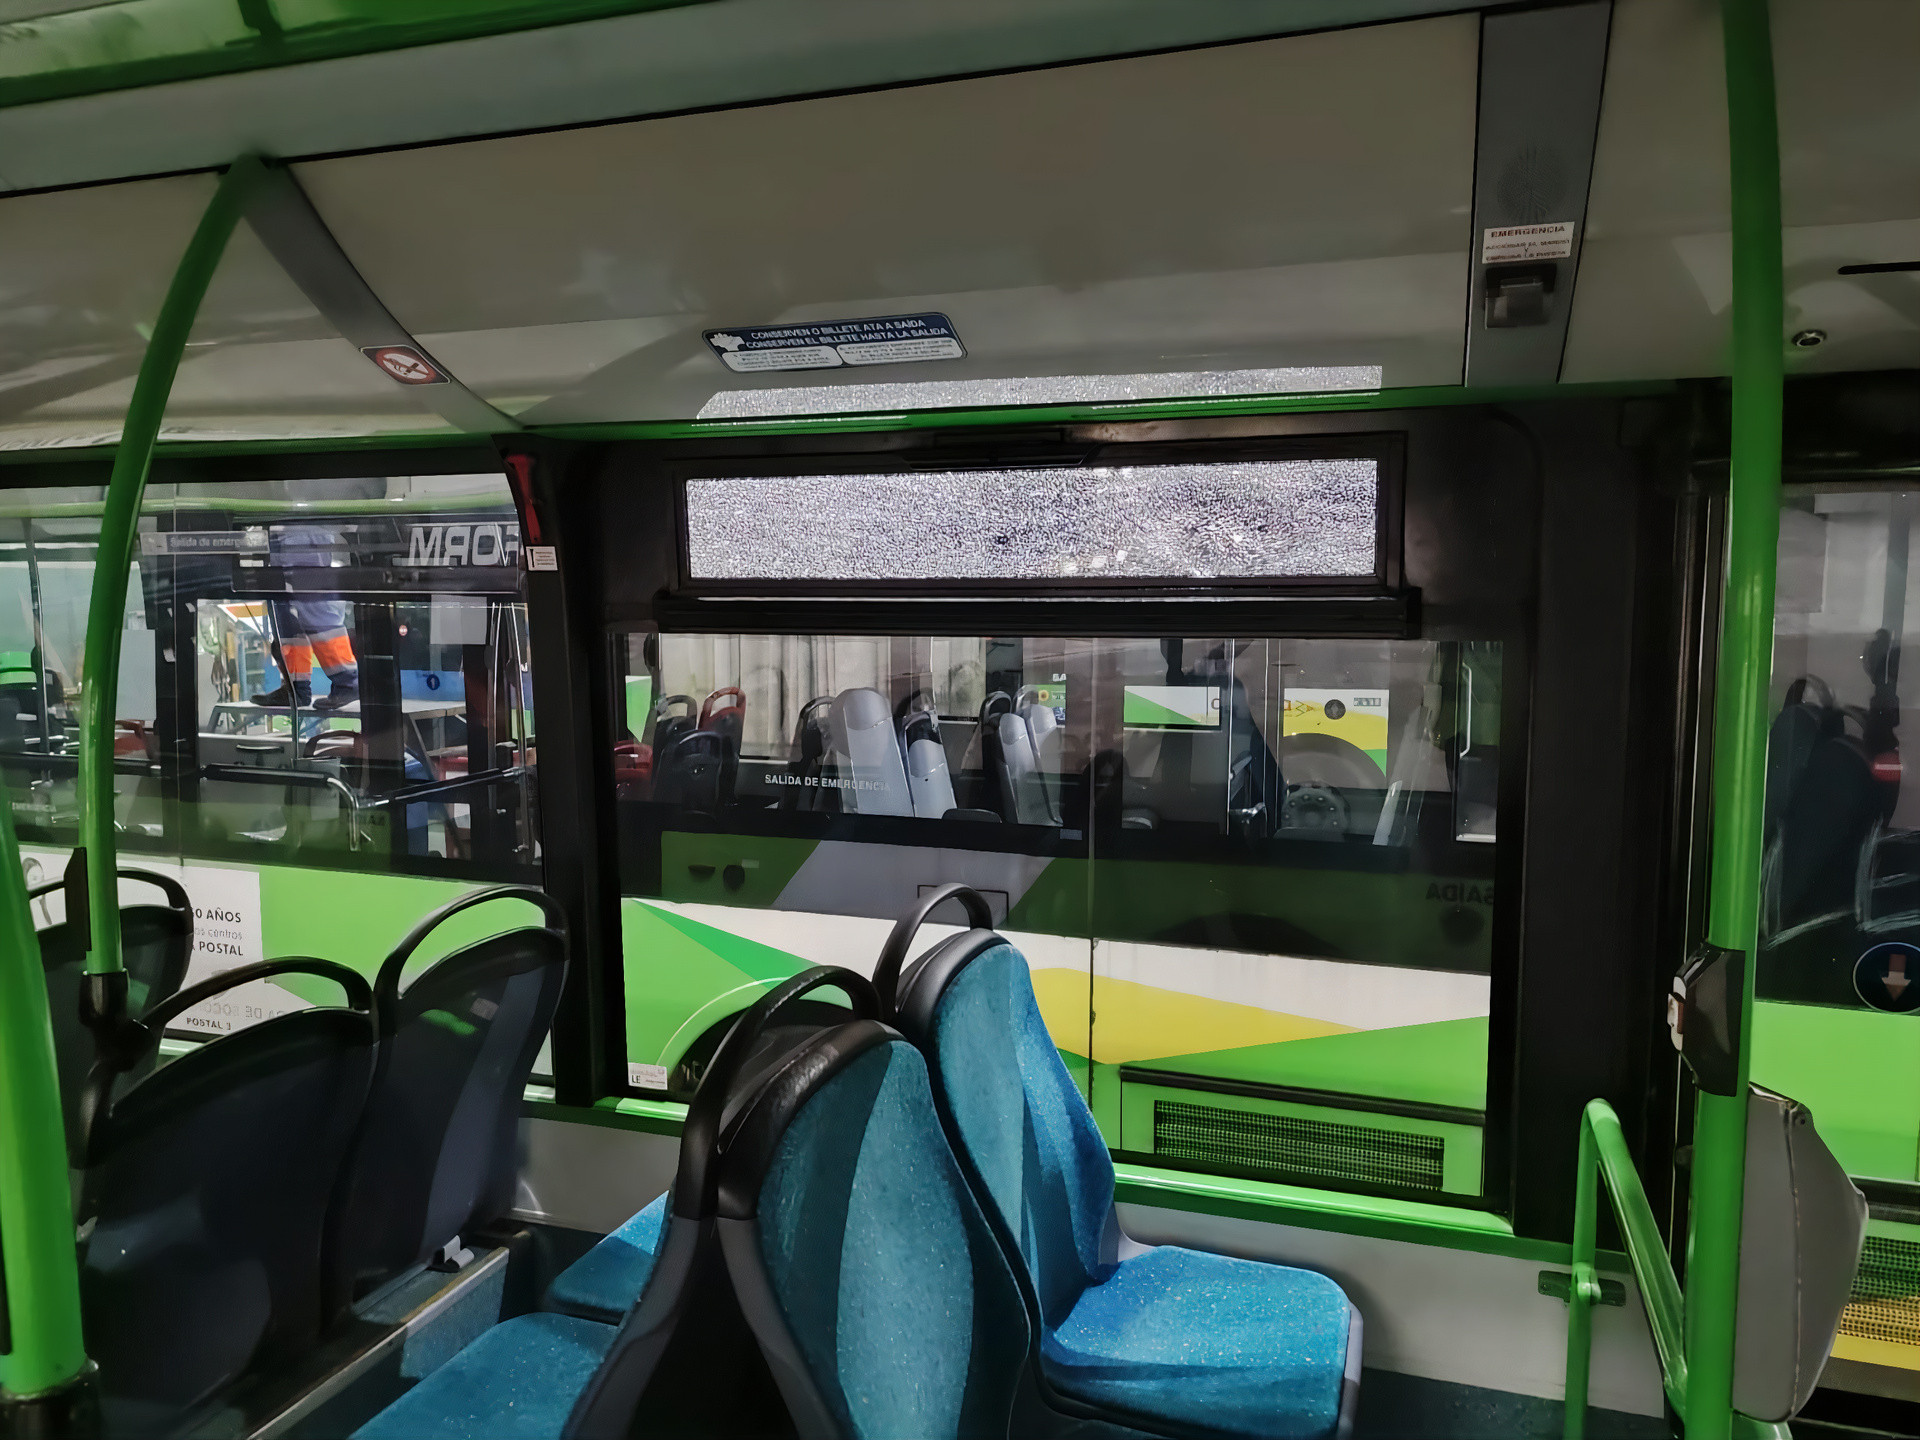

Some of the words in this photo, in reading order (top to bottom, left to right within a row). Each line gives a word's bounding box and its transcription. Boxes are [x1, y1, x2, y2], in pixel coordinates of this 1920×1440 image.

[1490, 225, 1566, 238] EMERGENCIA
[751, 328, 811, 340] CONSERVEN
[811, 327, 820, 335] O
[820, 324, 863, 335] BILLETE
[863, 323, 885, 332] ATA
[885, 322, 894, 330] A
[894, 319, 926, 329] SAÍDA
[745, 338, 805, 349] CONSERVEN
[805, 337, 819, 345] EL
[819, 333, 862, 344] BILLETE
[861, 331, 895, 341] HASTA
[910, 327, 949, 337] SALIDA
[764, 774, 802, 786] SALIDA
[804, 776, 819, 787] DE
[206, 906, 242, 923] AÑOS
[198, 941, 244, 956] POSTAL
[186, 1017, 224, 1030] POSTAL
